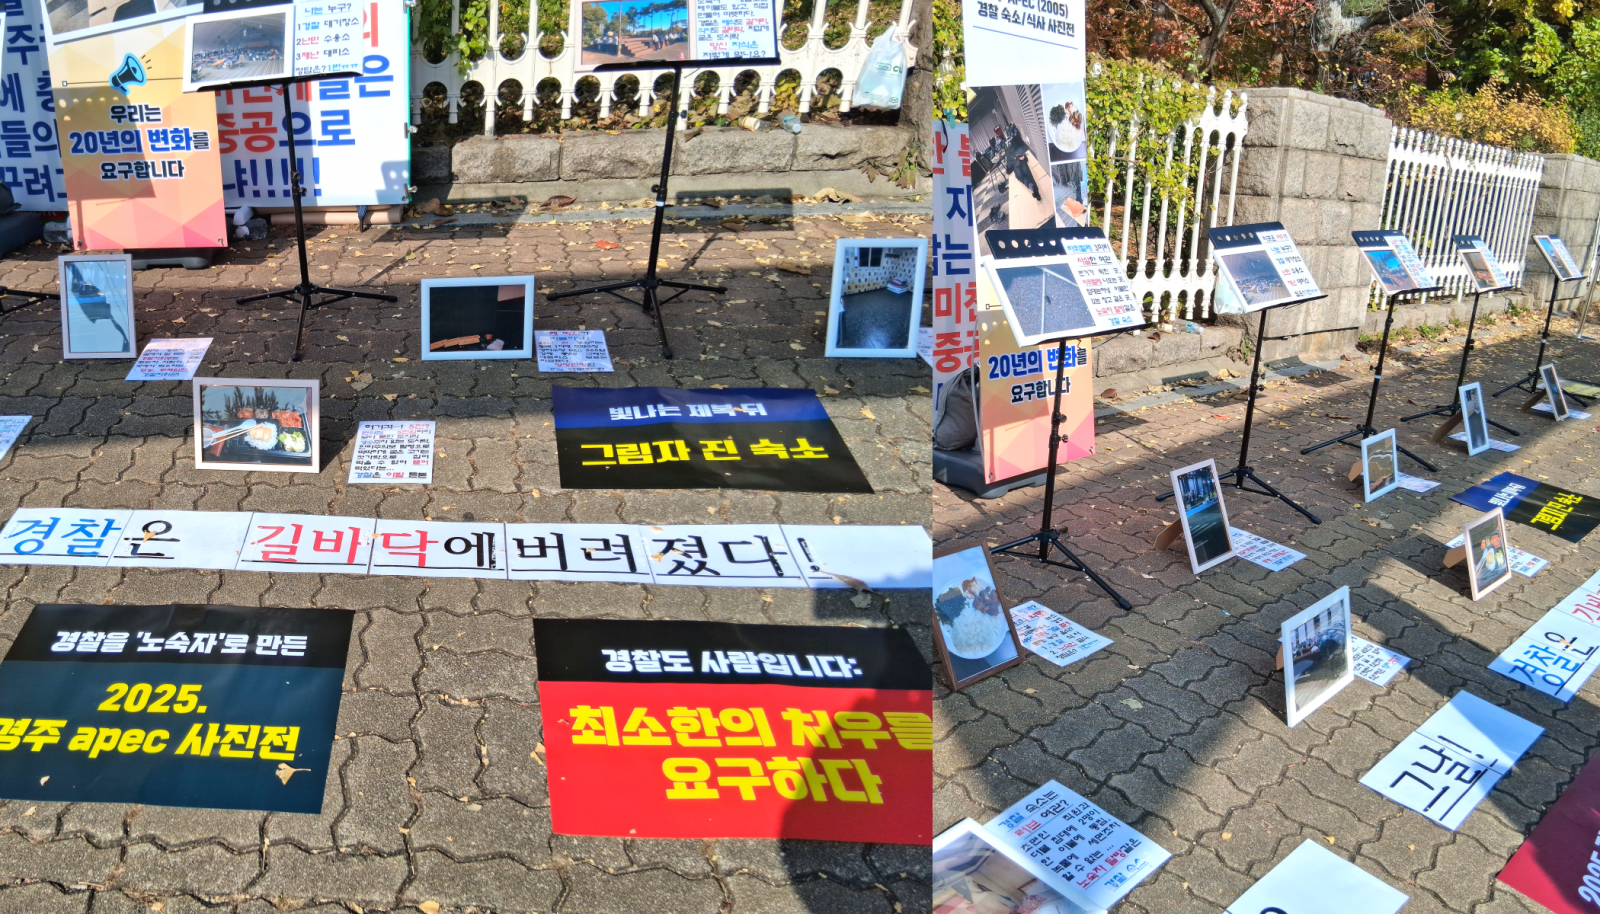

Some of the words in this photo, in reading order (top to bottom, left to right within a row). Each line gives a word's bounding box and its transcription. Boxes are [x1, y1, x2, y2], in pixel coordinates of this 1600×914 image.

[305, 6, 323, 15] 나는
[328, 3, 352, 13] 누구?
[977, 1, 999, 20] 경찰
[1001, 7, 1046, 31] 숙소/식사
[1047, 18, 1075, 37] 사진전
[1008, 0, 1035, 9] EC
[1037, 0, 1069, 19] (2005)
[324, 17, 359, 28] 대기장소
[324, 33, 350, 43] 수용소
[709, 42, 727, 51] 당신
[732, 40, 759, 49] 자식은
[324, 48, 350, 57] 대피소
[110, 104, 161, 124] 우리는
[69, 129, 143, 154] 20년의
[147, 128, 210, 152] 변화를
[101, 160, 185, 179] 요구합니다
[988, 349, 1043, 380] 20년의
[1047, 345, 1087, 370] 변화를
[609, 404, 682, 421] 빛나는
[686, 403, 740, 417] 제복
[740, 403, 768, 416] 뒤
[580, 440, 690, 466] 그림자
[699, 440, 741, 461] 진
[749, 438, 829, 460] 숙소
[1547, 501, 1573, 513] 진
[1553, 492, 1583, 505] 숙소
[1530, 506, 1568, 531] 그림자
[7, 516, 181, 557] 경찰은
[51, 631, 130, 653] 경찰을
[136, 631, 250, 654] '노숙자'로
[255, 635, 308, 656] 만든
[601, 649, 694, 673] 경찰도
[1508, 631, 1594, 687] 경찰은
[97, 682, 208, 714] 2025.
[0, 718, 68, 752] 경주
[67, 725, 170, 759] apec
[174, 723, 300, 761] 사진전
[569, 704, 777, 747] 최소한의
[780, 707, 933, 750] 처우를
[662, 756, 884, 804] 요구하다
[997, 811, 1025, 828] 경찰
[1024, 790, 1060, 813] 숙소는
[1014, 820, 1042, 837] 러브
[1040, 799, 1070, 819] 여관?
[1020, 830, 1051, 853] 초면인
[1062, 802, 1091, 822] 직원과
[1030, 844, 1052, 858] 더블
[1050, 824, 1079, 845] 침대에
[1077, 808, 1101, 826] 2명이
[1040, 856, 1054, 867] 한
[1058, 833, 1086, 852] 이불에
[1051, 853, 1080, 873] 녹물에
[1088, 821, 1122, 846] 세면조차
[1061, 873, 1075, 882] 할
[1075, 864, 1085, 873] 수
[1084, 850, 1105, 865] 없는
[1076, 864, 1108, 889] 노숙자
[1104, 872, 1127, 889] 경찰
